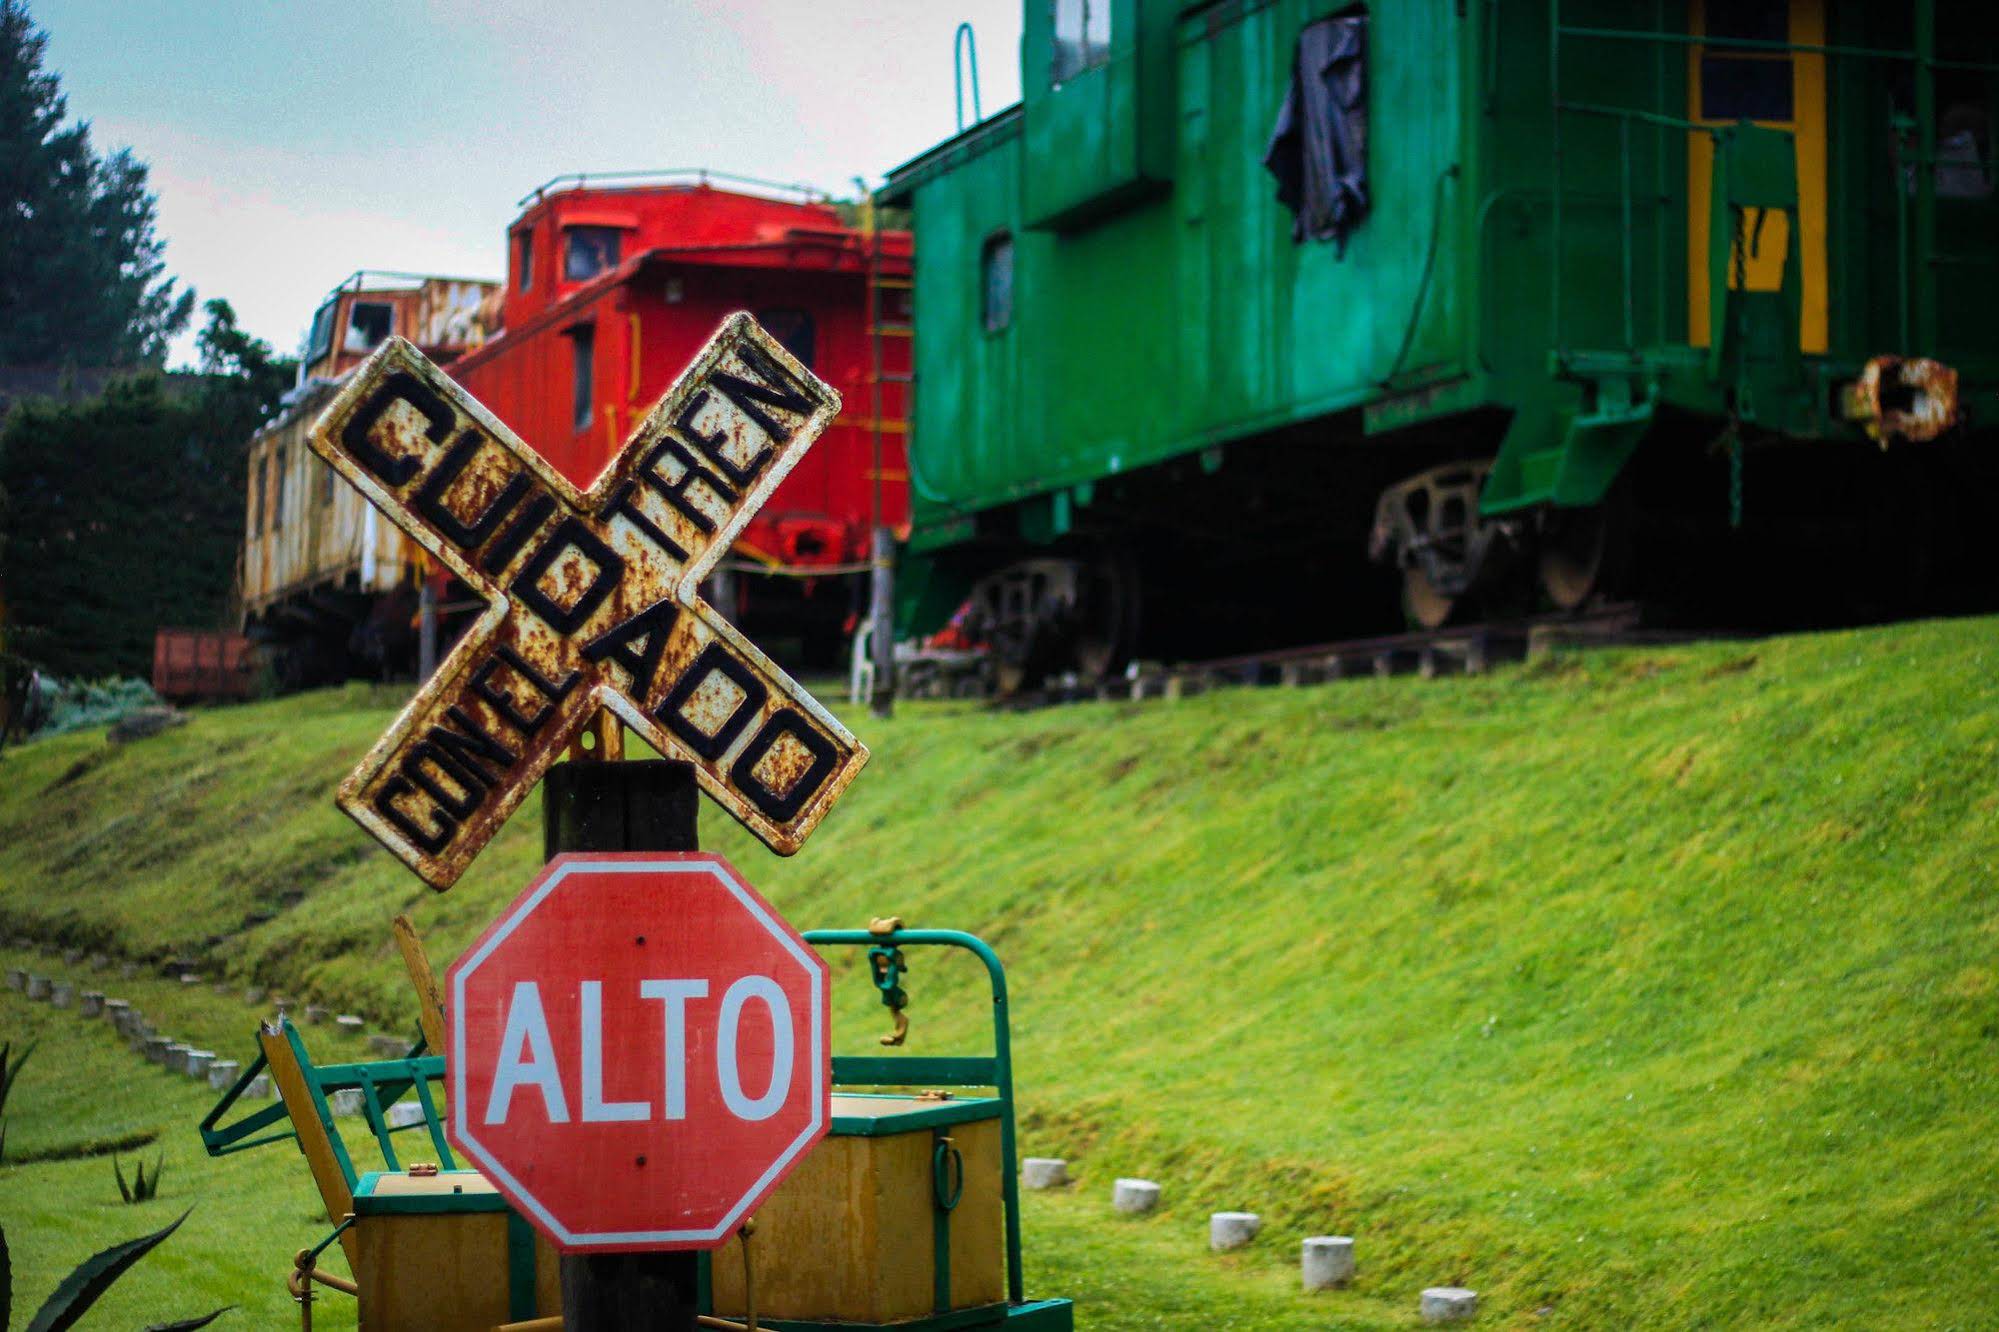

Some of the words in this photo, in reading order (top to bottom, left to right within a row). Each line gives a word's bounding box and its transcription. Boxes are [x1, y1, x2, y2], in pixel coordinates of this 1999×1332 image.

[342, 372, 839, 823] CUIDADO
[375, 705, 517, 854] CON
[471, 646, 582, 735] EL
[600, 345, 824, 563] TREN
[484, 975, 794, 1125] ALTO
